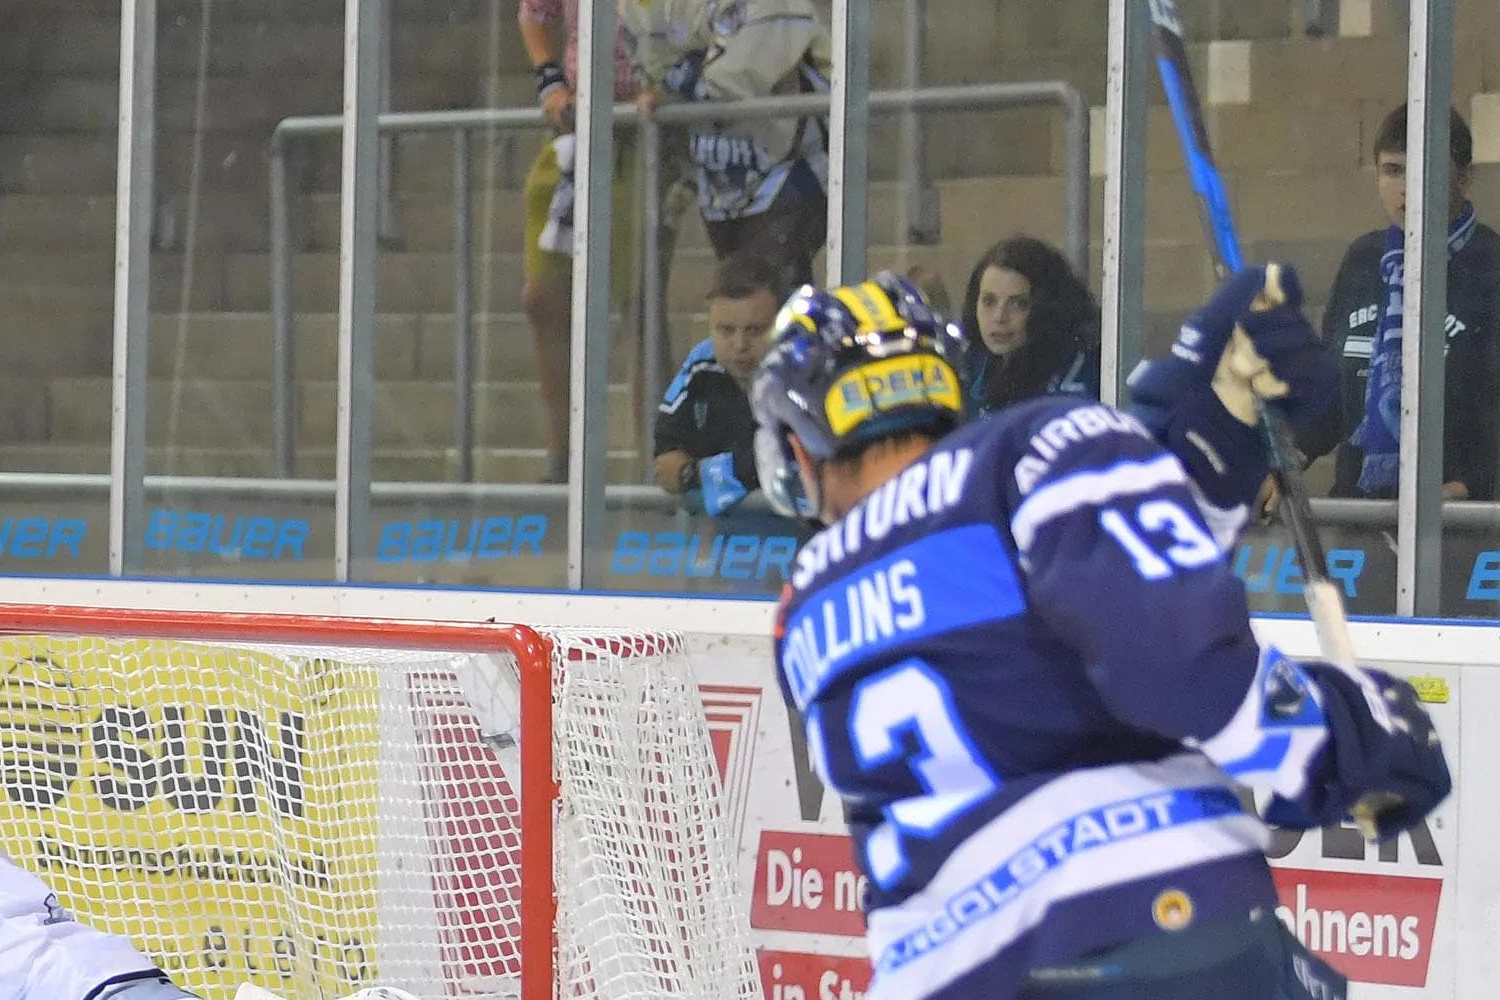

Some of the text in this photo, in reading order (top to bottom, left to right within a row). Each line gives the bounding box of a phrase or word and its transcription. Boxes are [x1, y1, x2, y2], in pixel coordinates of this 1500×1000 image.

[143, 508, 314, 561] BAUER
[376, 514, 549, 564] BAUER
[793, 447, 973, 590] SATURN
[1098, 496, 1223, 583] 13
[609, 531, 797, 580] BAUER
[766, 848, 823, 912] Die
